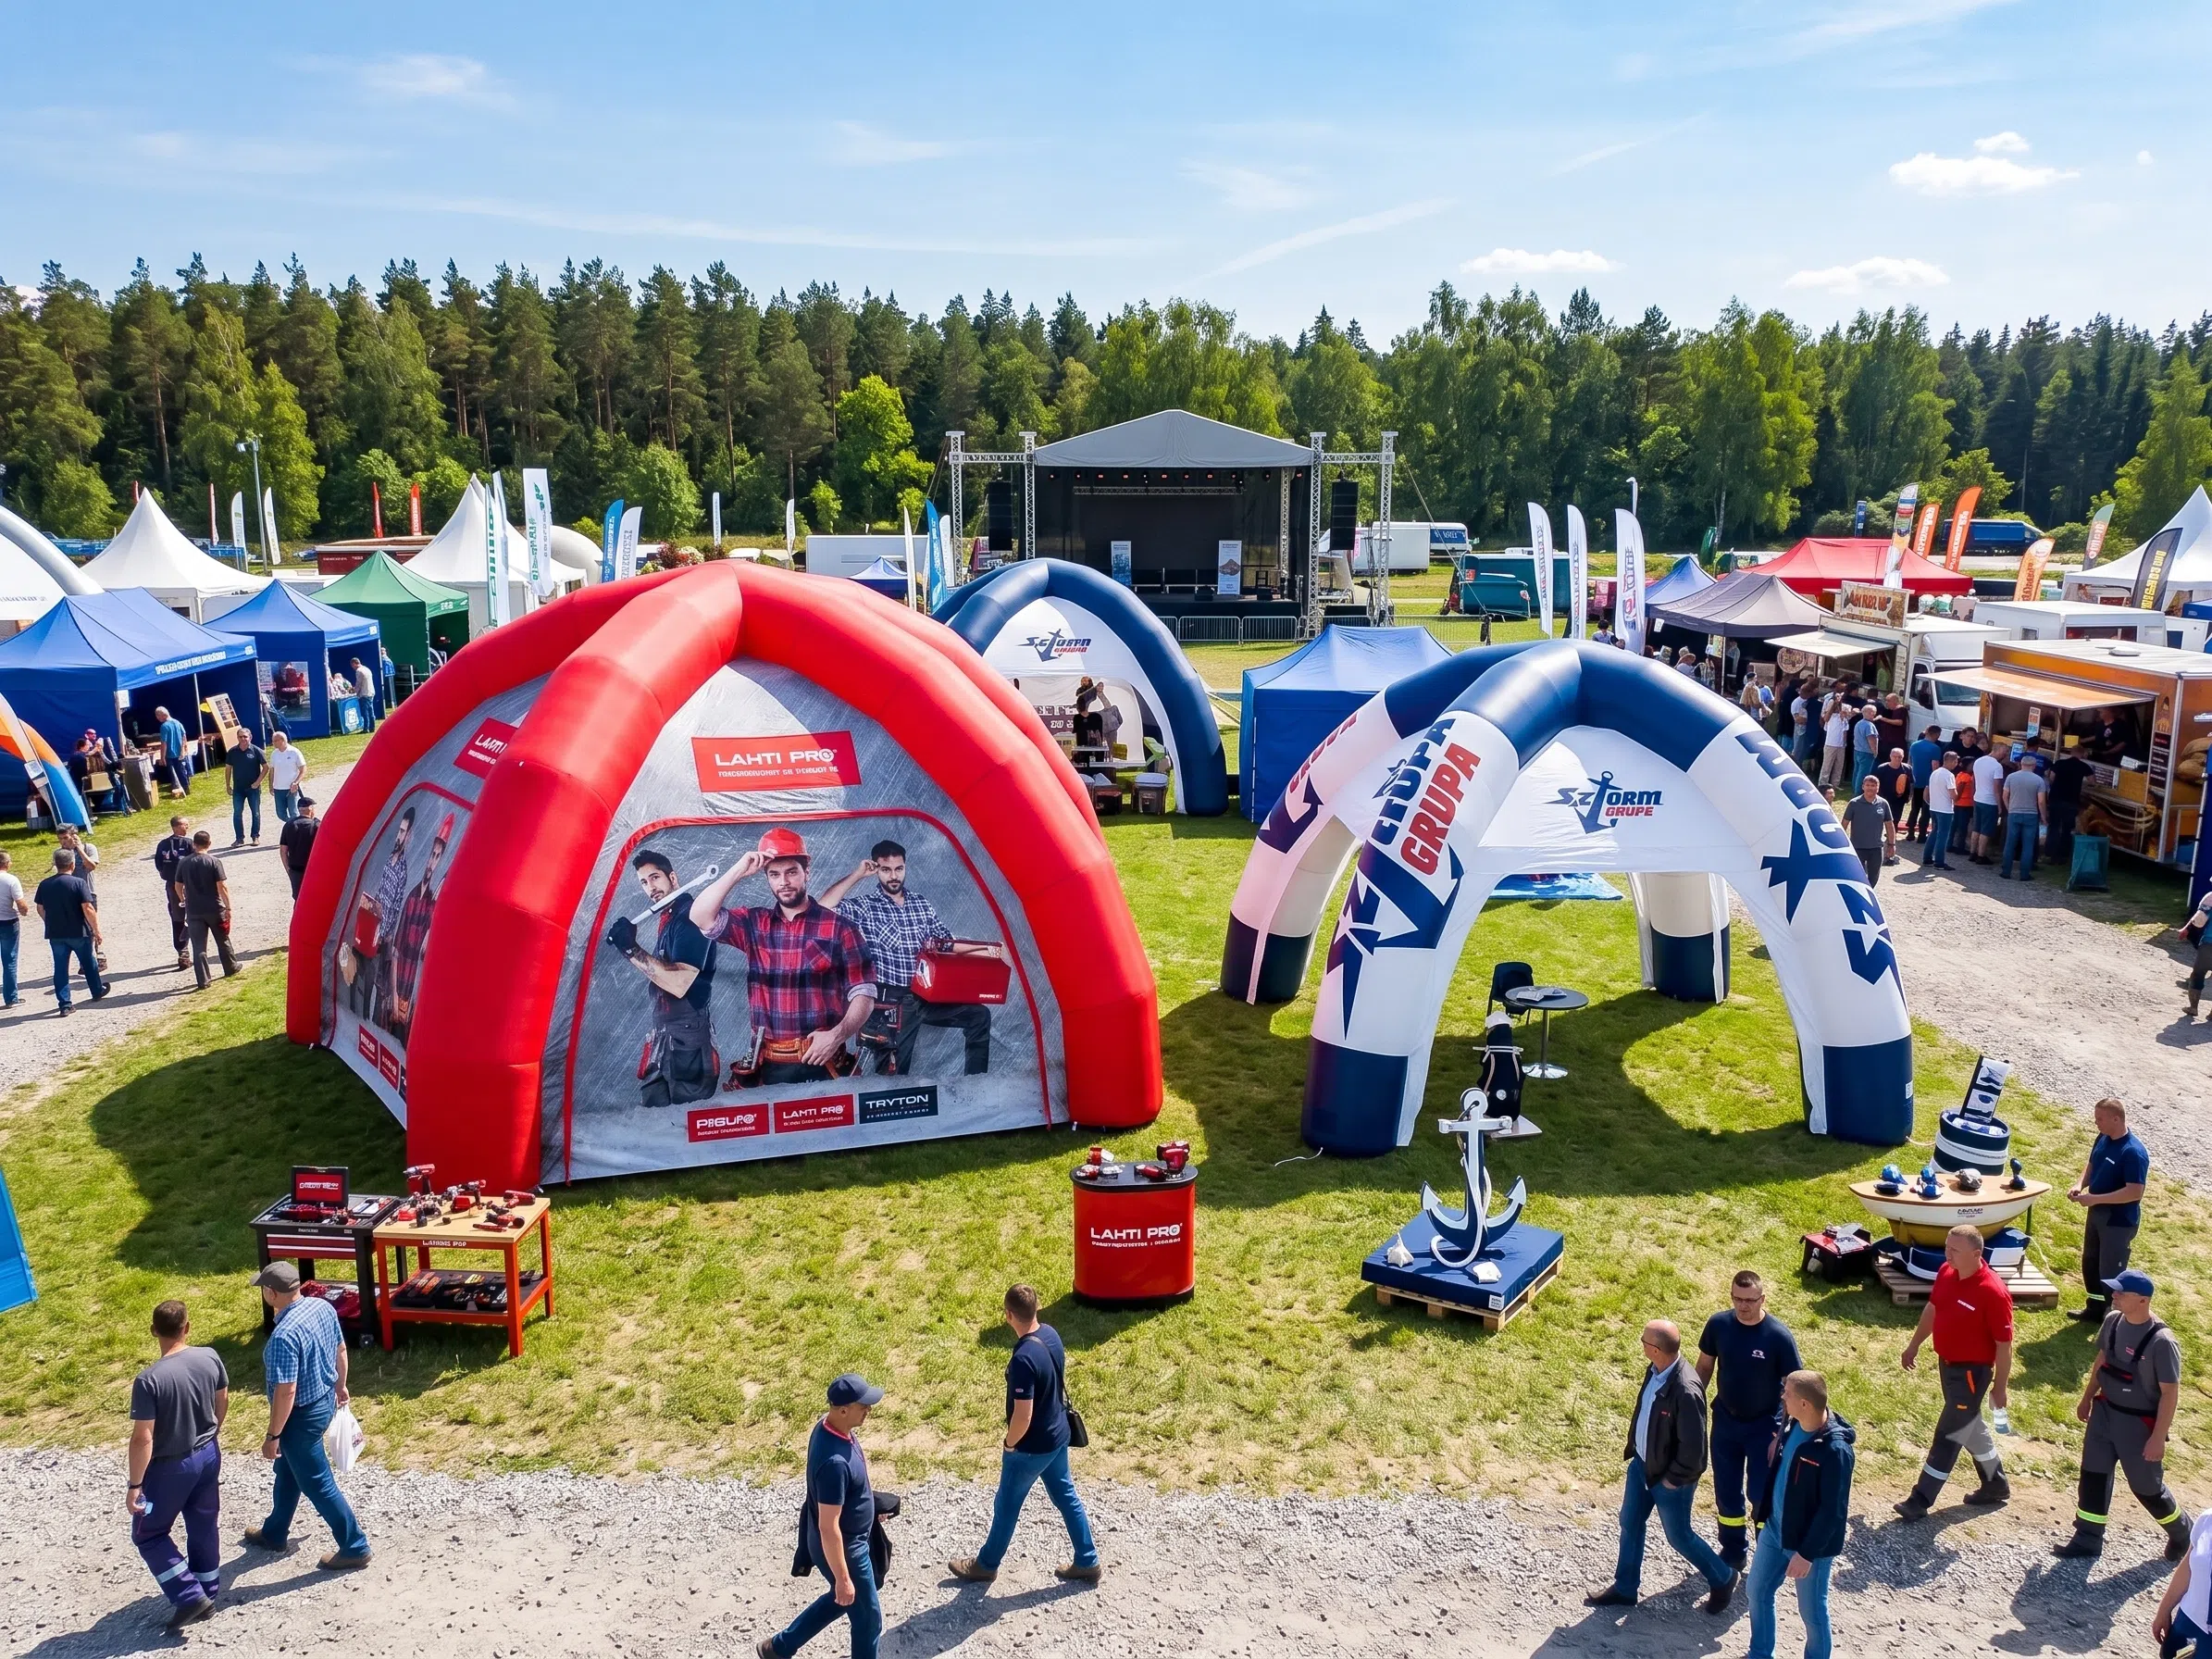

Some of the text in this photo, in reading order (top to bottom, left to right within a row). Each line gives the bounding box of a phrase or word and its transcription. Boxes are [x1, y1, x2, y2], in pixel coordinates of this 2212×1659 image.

[715, 748, 835, 767] LAHTI PRO
[1399, 742, 1481, 876] GRUPA
[1605, 806, 1655, 817] GRUPE
[865, 1094, 929, 1109] TRYTON
[821, 1104, 844, 1115] PRO
[1090, 1224, 1181, 1240] LAHTI PRO
